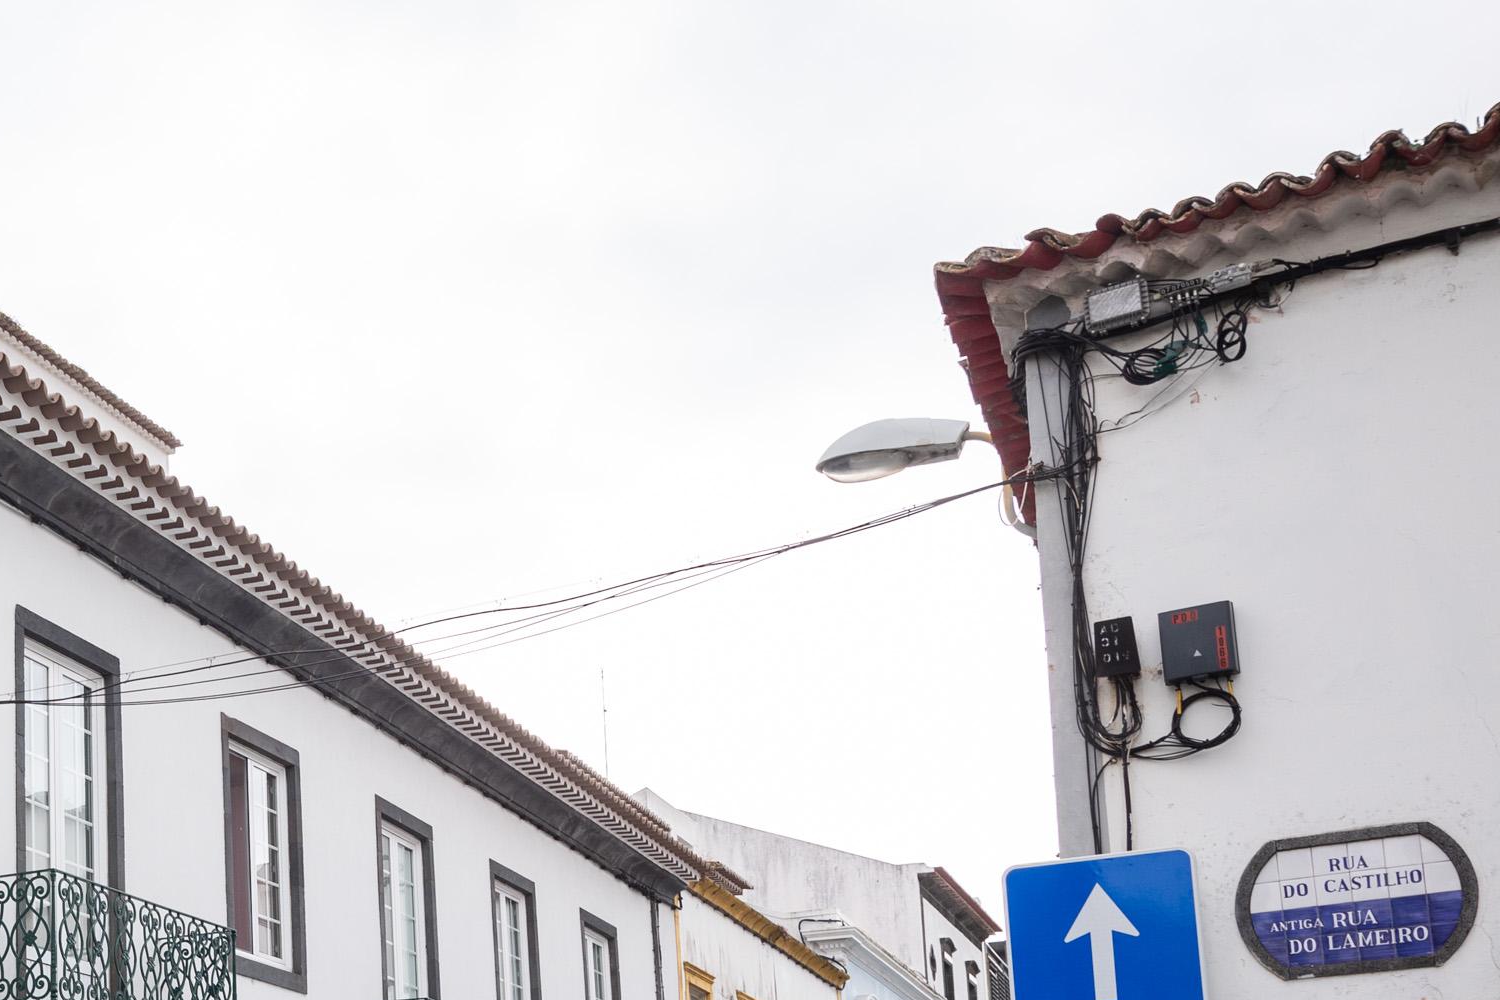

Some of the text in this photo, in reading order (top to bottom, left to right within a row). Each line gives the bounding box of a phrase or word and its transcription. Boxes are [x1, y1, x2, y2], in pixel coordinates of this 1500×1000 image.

[1328, 856, 1369, 872] RUA
[1283, 869, 1423, 898] DO CASTILHO
[1270, 909, 1378, 933] ANTIGA RUA
[1289, 925, 1429, 955] DO LAMEIRO
